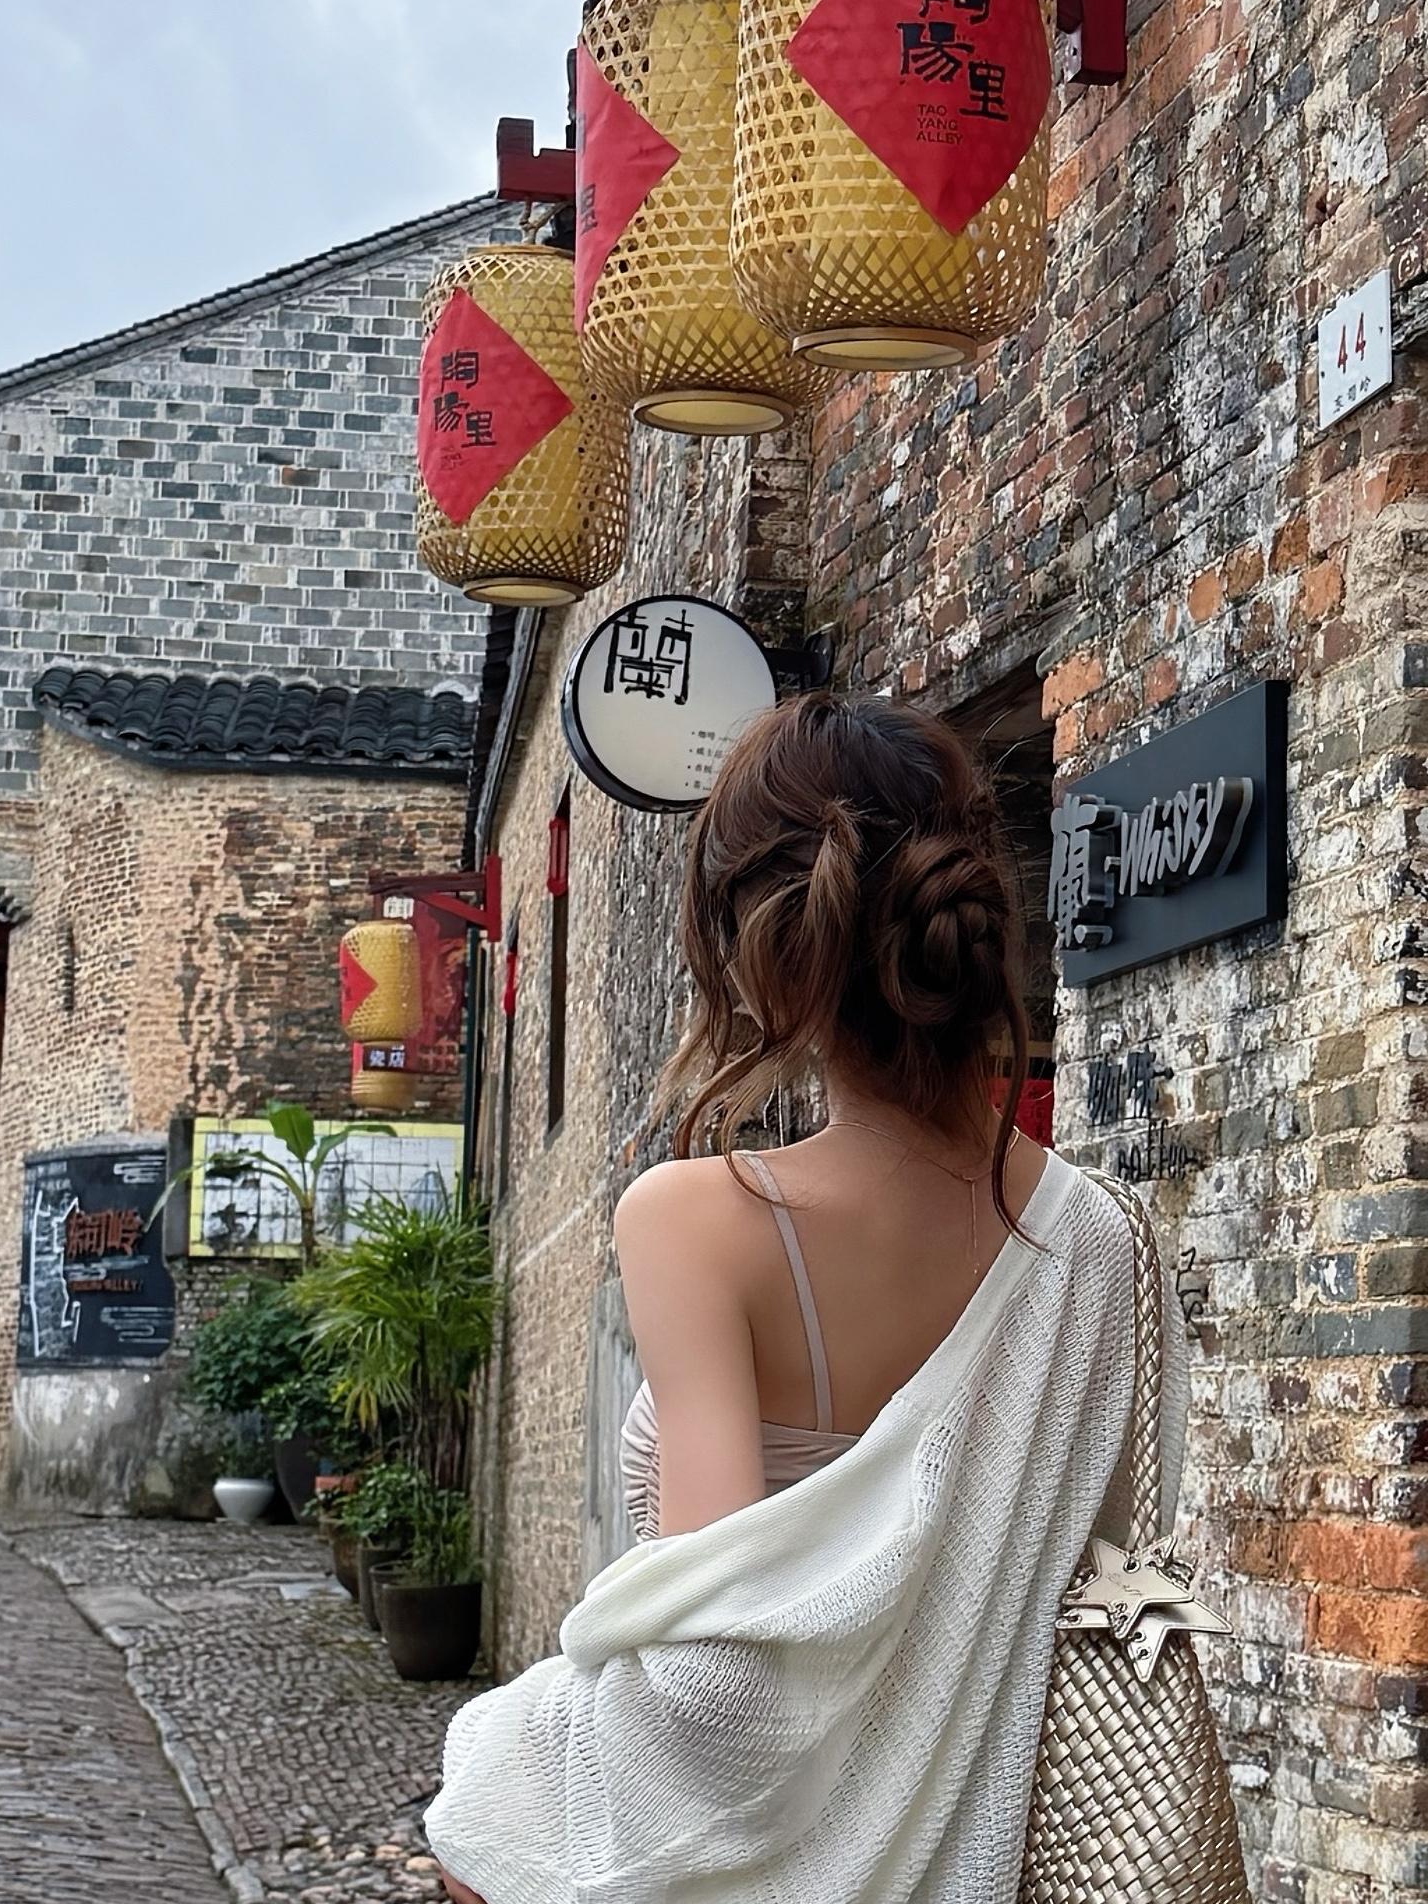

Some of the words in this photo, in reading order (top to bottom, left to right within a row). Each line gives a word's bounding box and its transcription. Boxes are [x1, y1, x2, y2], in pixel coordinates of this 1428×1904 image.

[917, 103, 947, 117] TAO
[917, 118, 958, 131] YANG
[916, 131, 963, 145] ALLEY
[1337, 312, 1366, 374] 44
